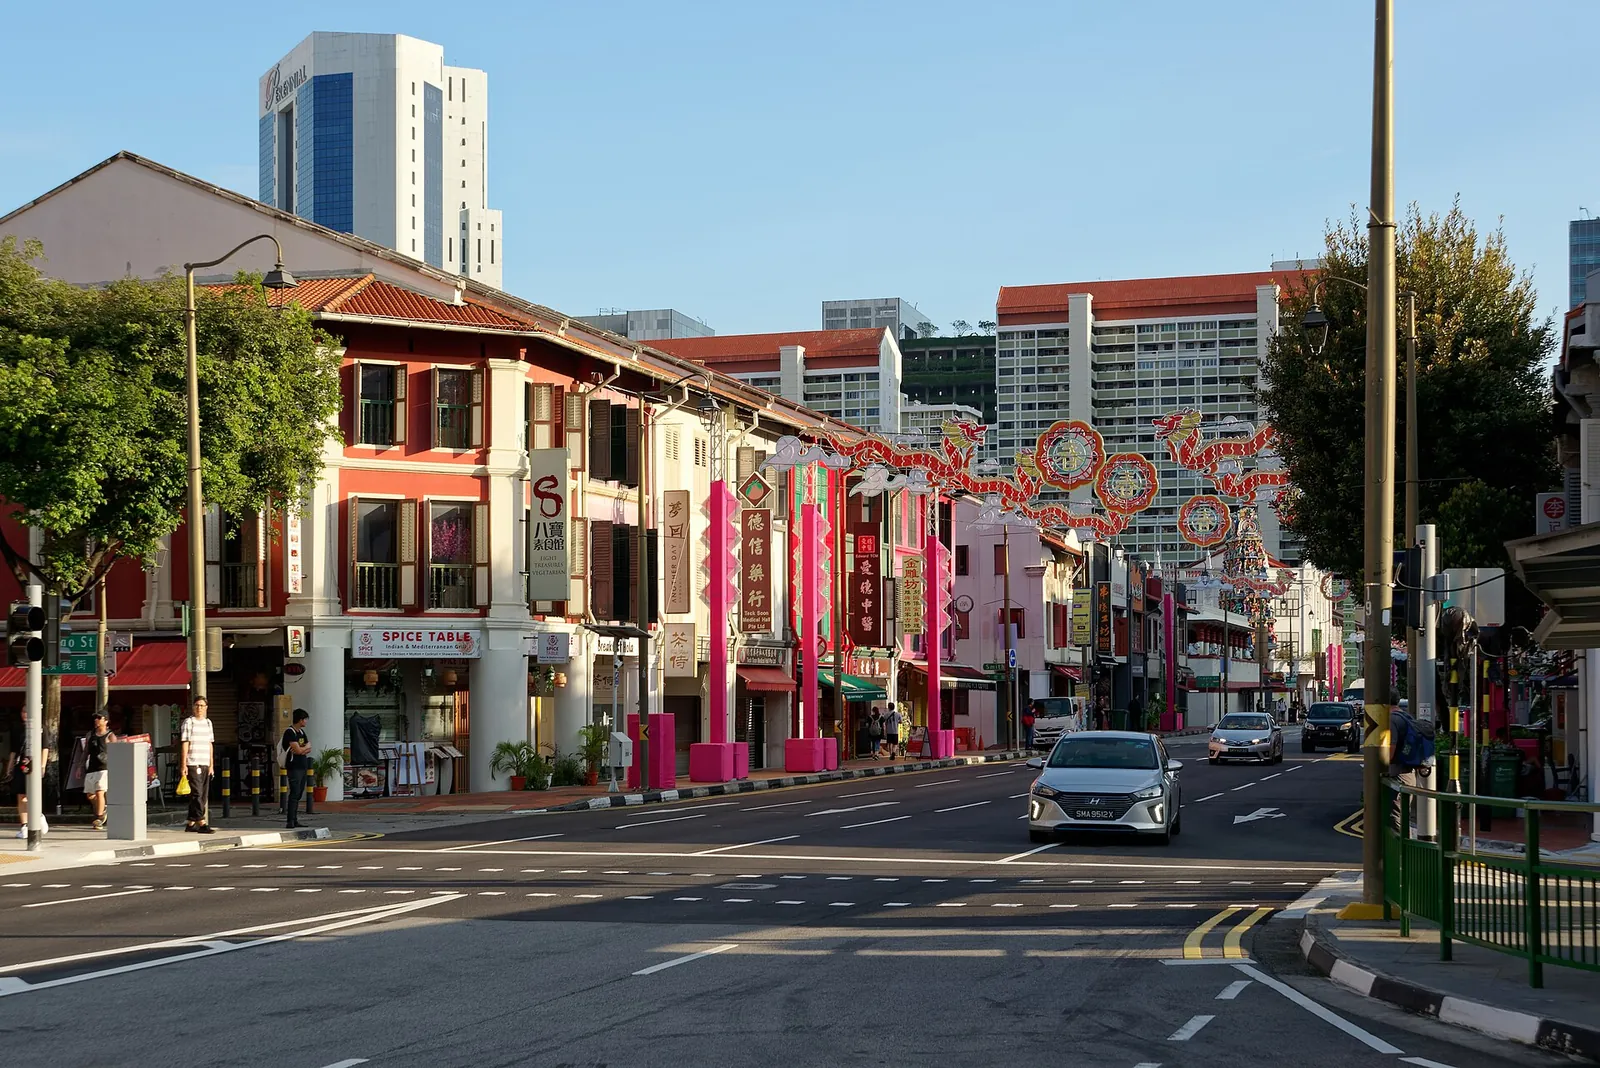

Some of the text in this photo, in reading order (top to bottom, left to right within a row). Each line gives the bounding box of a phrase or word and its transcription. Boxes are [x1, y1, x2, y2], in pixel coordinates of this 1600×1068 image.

[81, 636, 93, 648] St
[382, 631, 471, 642] SPICE TABLE
